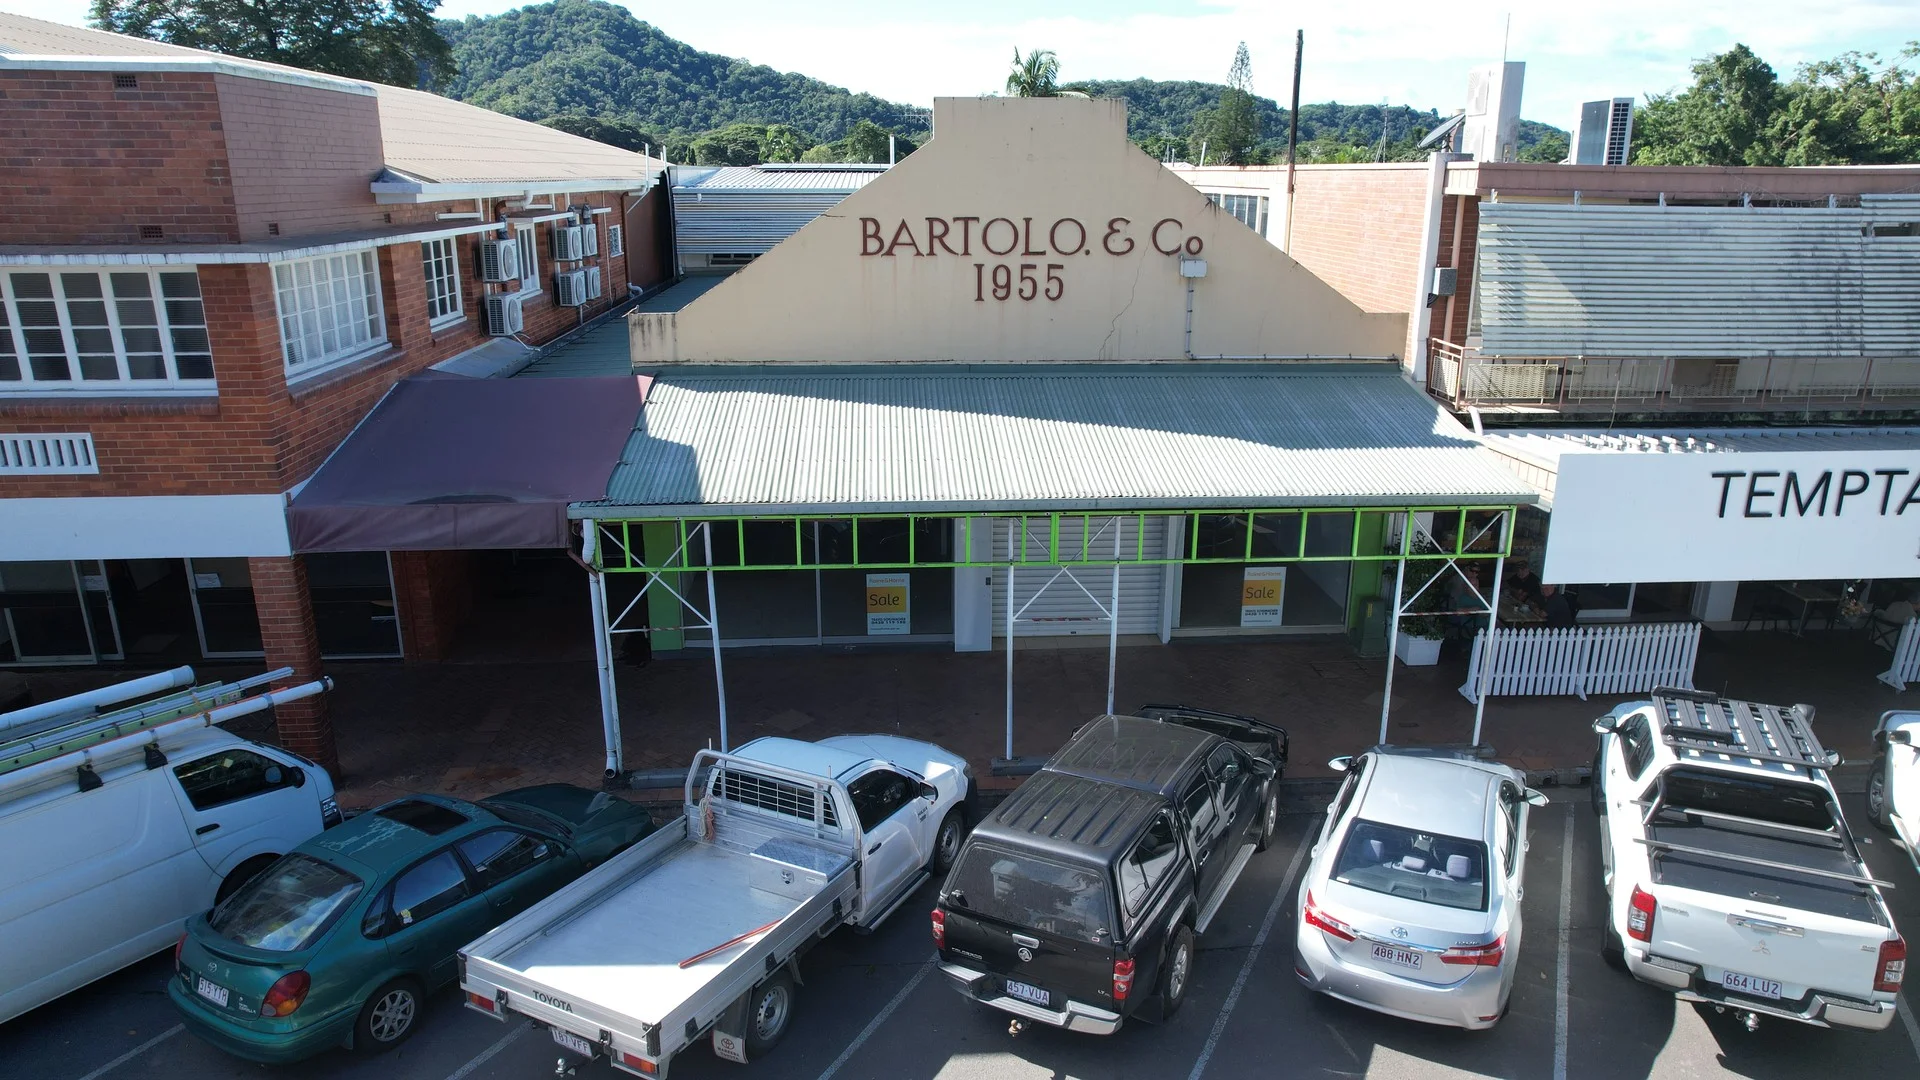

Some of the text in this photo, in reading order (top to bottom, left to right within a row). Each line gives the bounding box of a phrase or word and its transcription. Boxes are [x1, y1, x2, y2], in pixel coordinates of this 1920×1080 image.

[859, 217, 1204, 257] BARTOLO. & Co
[973, 264, 1065, 302] 1955
[869, 593, 900, 606] Sale
[1245, 586, 1275, 599] Sale
[532, 989, 573, 1013] TOYOTA
